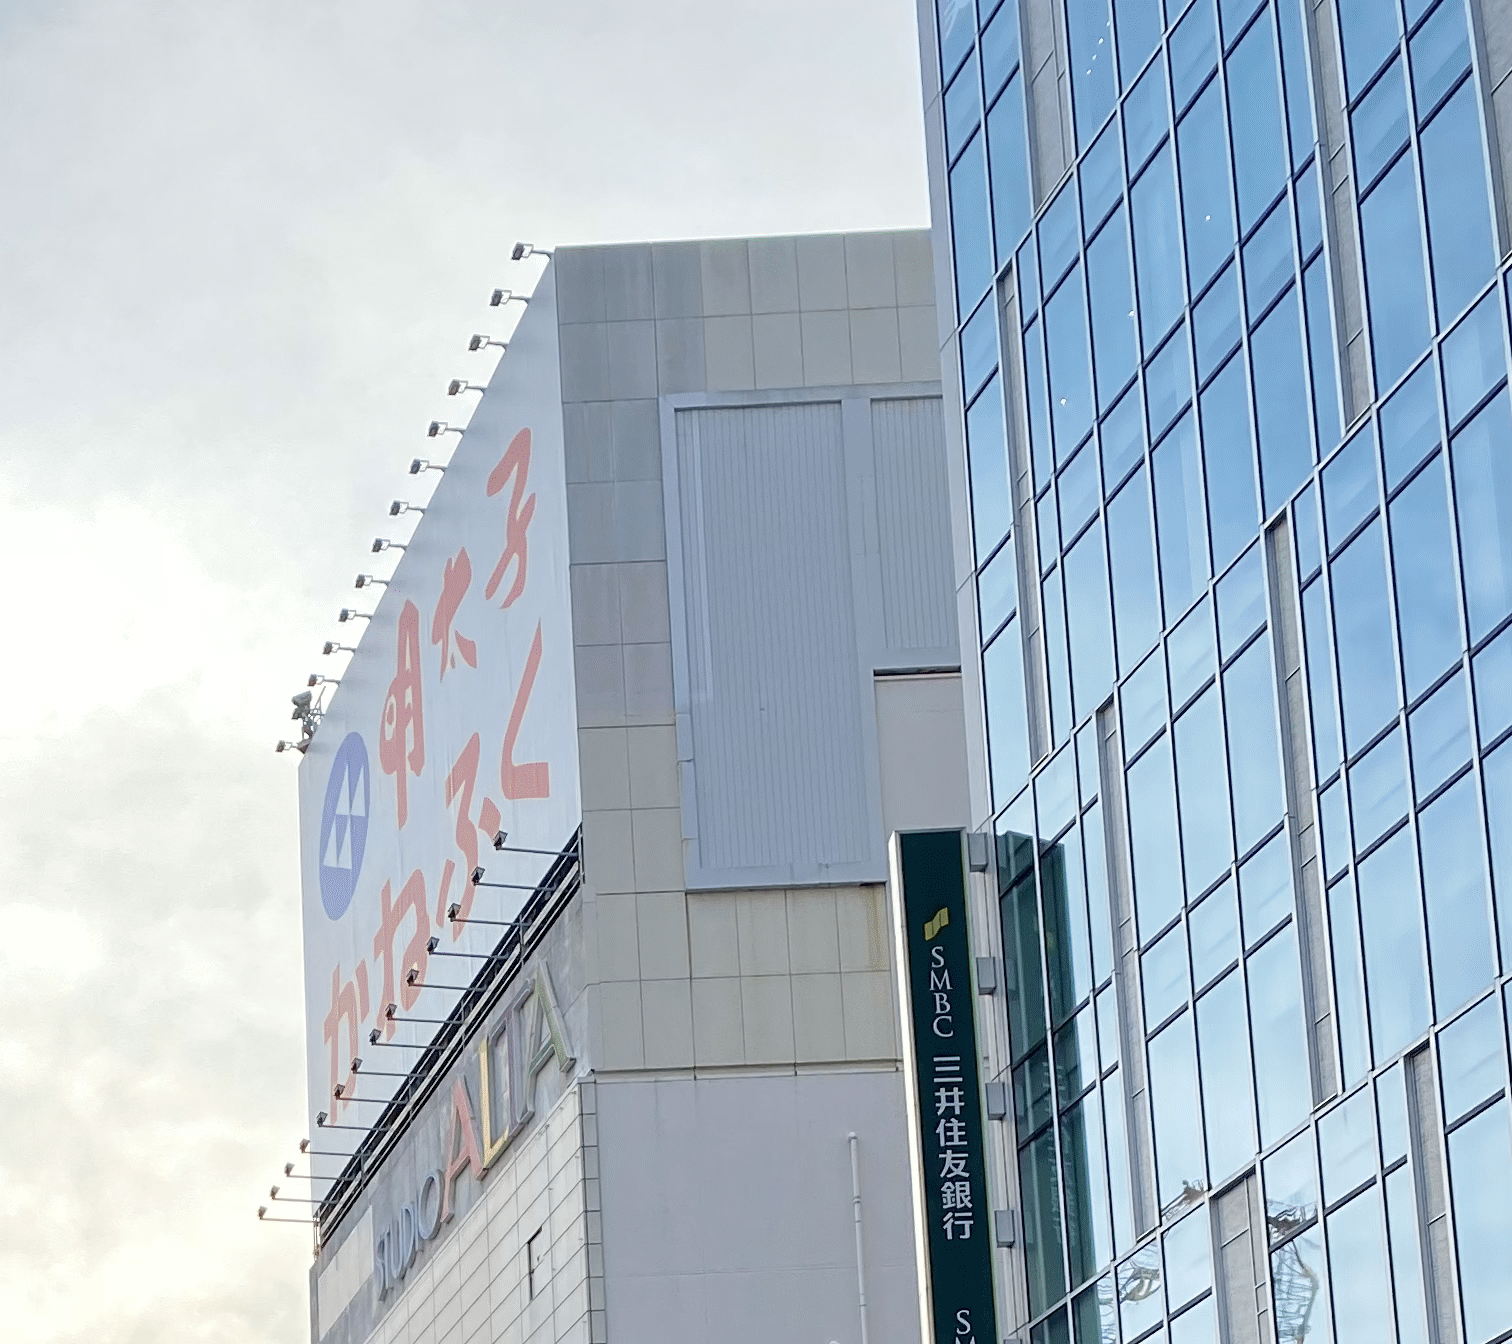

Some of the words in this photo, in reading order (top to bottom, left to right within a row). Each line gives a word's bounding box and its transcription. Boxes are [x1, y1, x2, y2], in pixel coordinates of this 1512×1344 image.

[323, 618, 550, 1124] かねふく
[440, 959, 576, 1224] ALTA
[928, 946, 955, 1038] SMBC
[932, 1056, 974, 1240] 三井住友銀行
